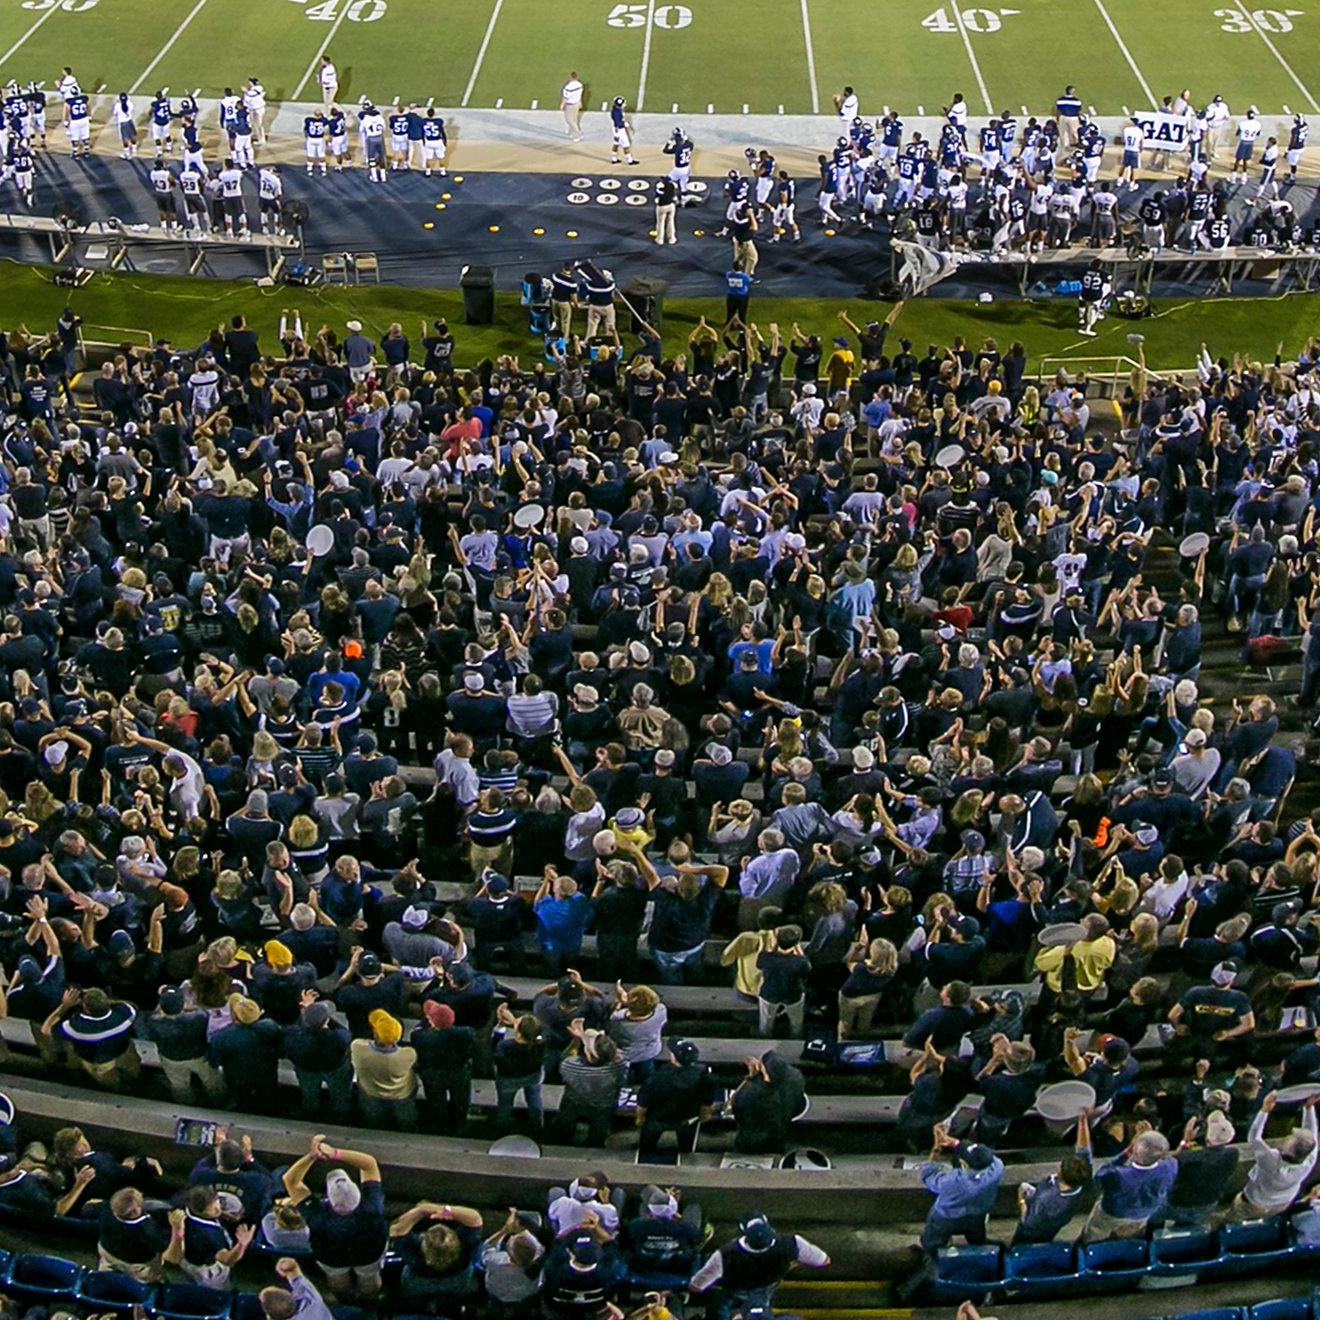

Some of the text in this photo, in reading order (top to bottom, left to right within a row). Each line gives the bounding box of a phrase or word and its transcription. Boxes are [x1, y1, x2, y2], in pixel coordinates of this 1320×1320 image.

[606, 3, 693, 30] 50
[920, 7, 1003, 33] 40
[1212, 8, 1296, 33] 30
[72, 104, 87, 116] 60
[394, 122, 408, 132] 50
[984, 134, 996, 146] 14
[900, 163, 912, 175] 19
[1212, 224, 1228, 238] 56
[1083, 275, 1102, 291] 92
